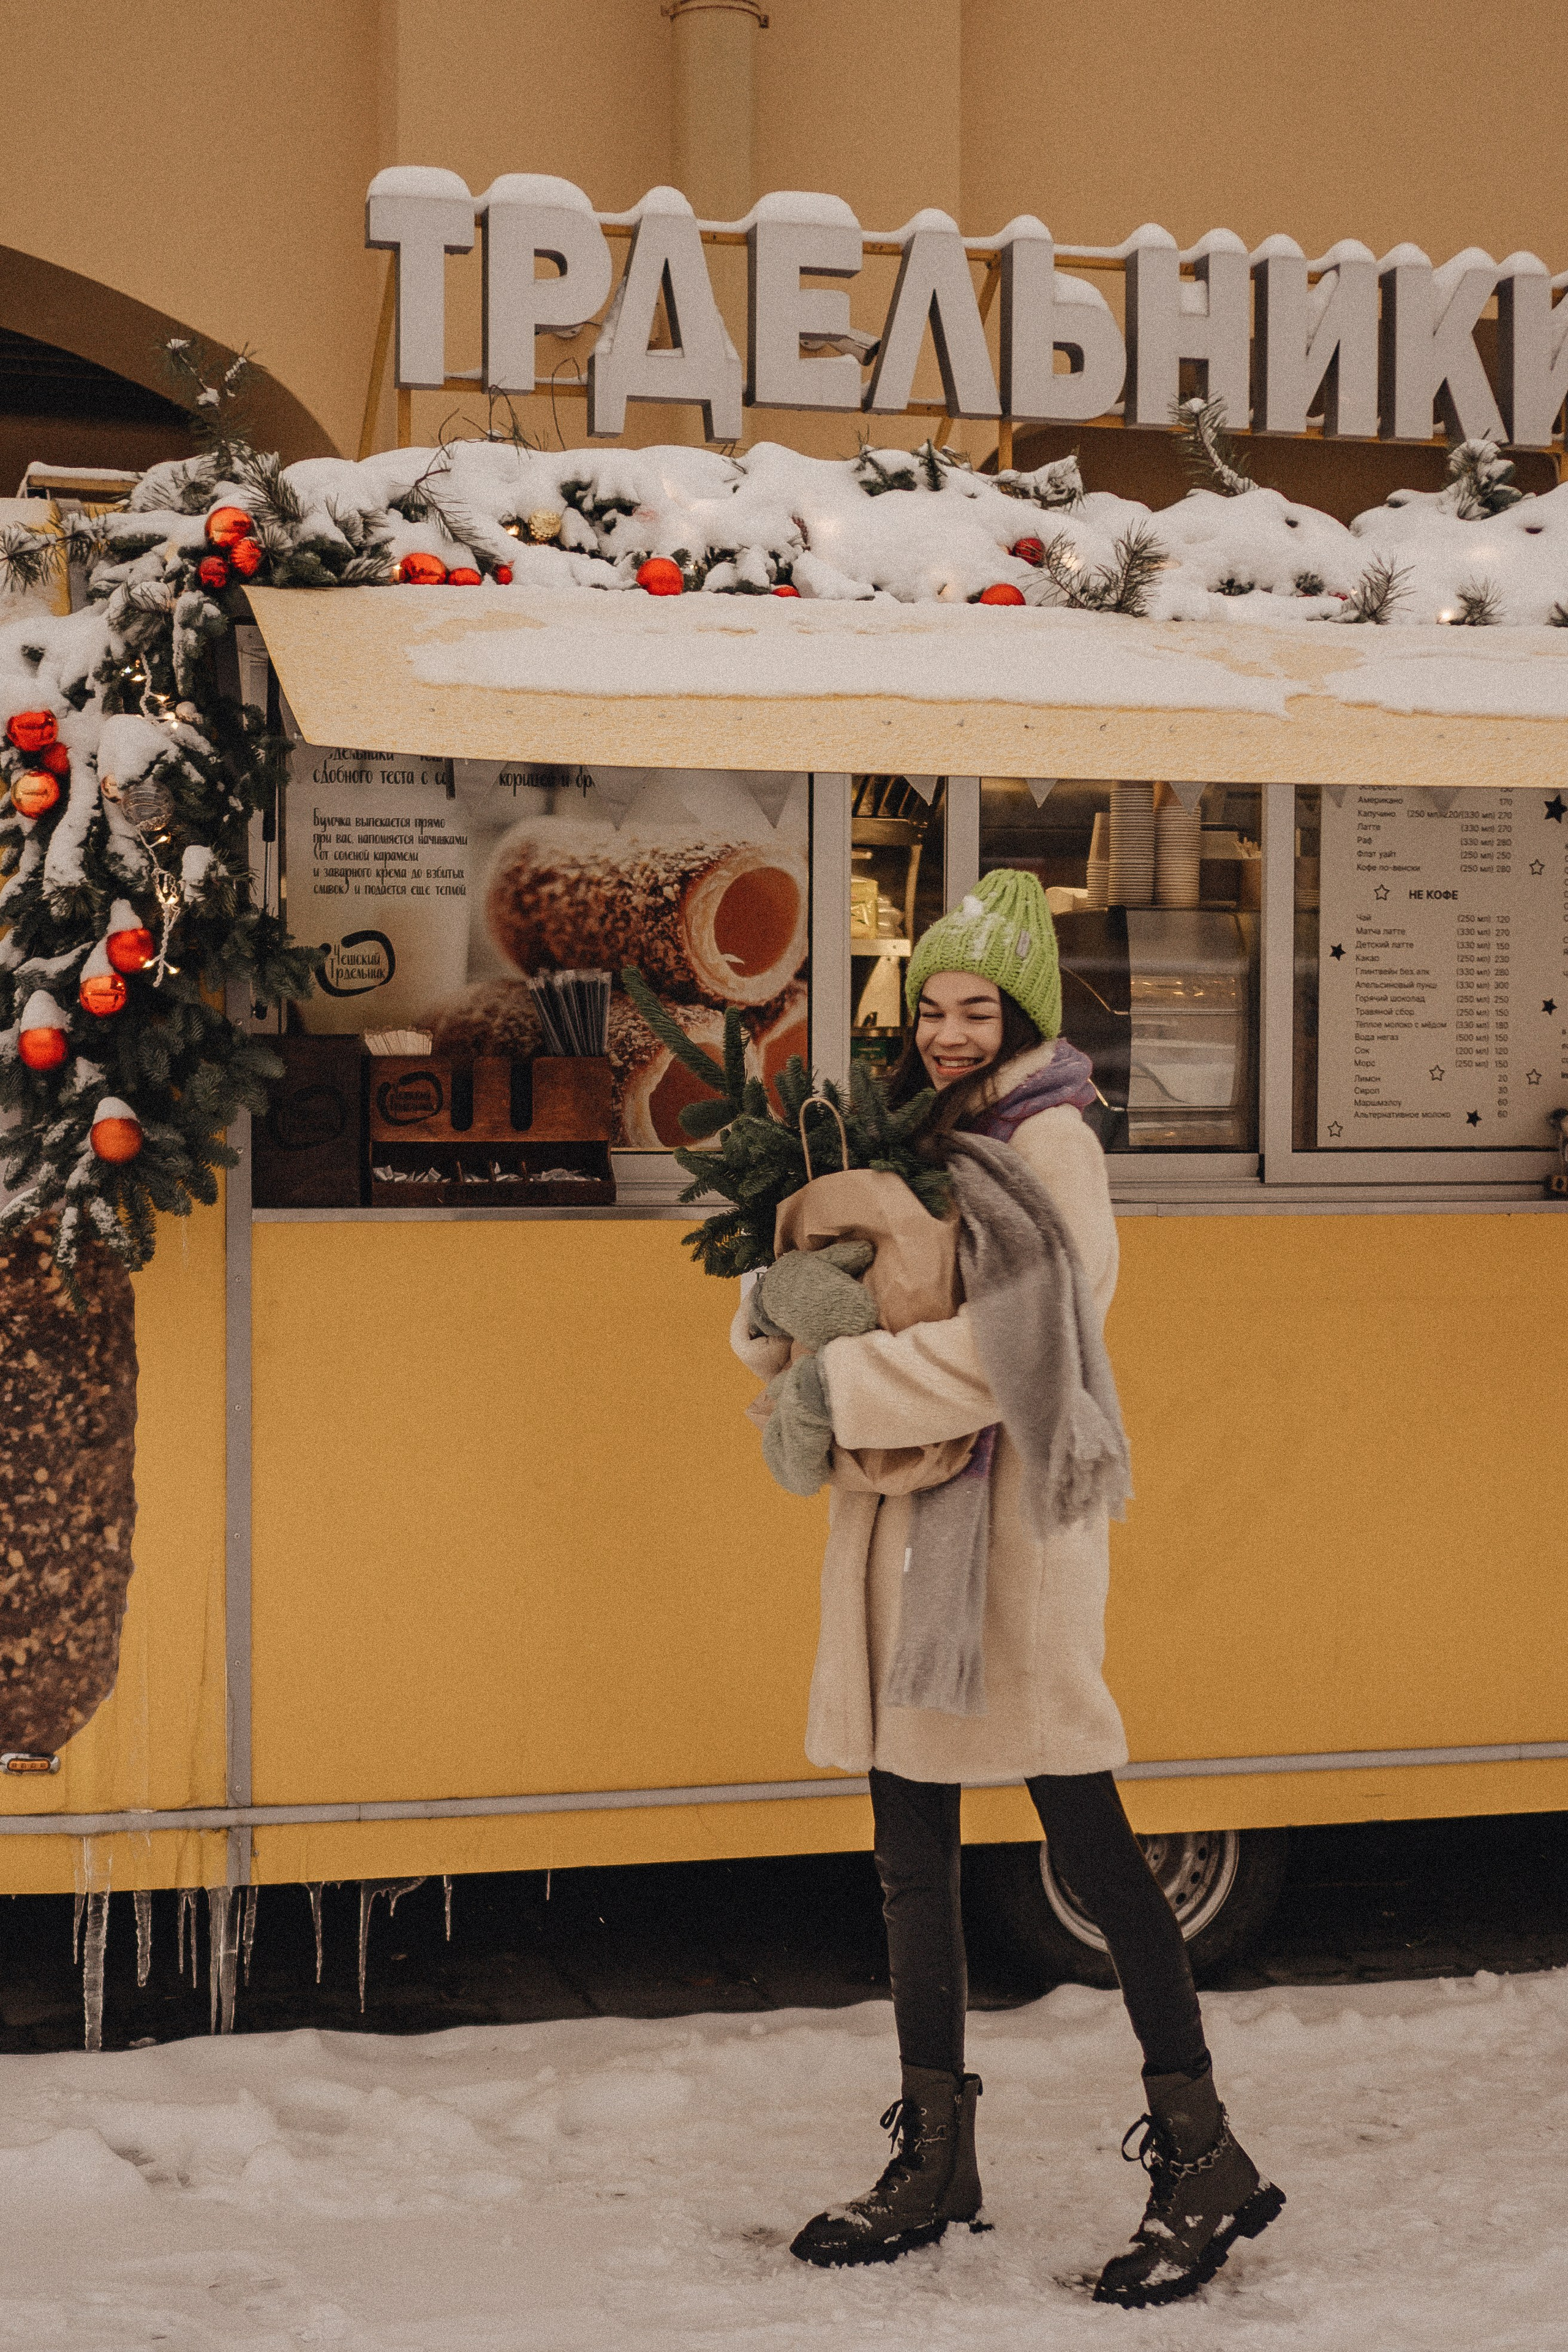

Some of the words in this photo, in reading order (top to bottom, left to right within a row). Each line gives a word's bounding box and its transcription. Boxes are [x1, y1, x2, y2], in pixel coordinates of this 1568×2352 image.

[313, 766, 374, 785] сдобного
[380, 770, 415, 785] теста
[421, 771, 429, 785] с
[313, 807, 351, 832] Булочка
[355, 817, 410, 828] выпекается
[415, 818, 445, 835] прямо
[313, 834, 331, 850] при
[358, 834, 414, 845] наполняется
[418, 834, 468, 845] начинками
[1357, 836, 1373, 845] Раф
[334, 850, 369, 861] соленой
[373, 851, 419, 868] карамели
[1356, 864, 1377, 872] Кофе
[313, 868, 320, 877] и
[323, 867, 372, 884] заварного
[375, 868, 407, 884] крема
[410, 869, 422, 879] до
[426, 866, 464, 878] взбитых
[354, 884, 360, 895] и
[364, 884, 407, 895] подается
[410, 884, 430, 895] еще
[435, 884, 467, 896] теплой
[1409, 890, 1423, 900] НЕ
[1427, 890, 1458, 900] КОФЕ
[334, 944, 380, 965] Чешский
[330, 958, 385, 987] Трдельник
